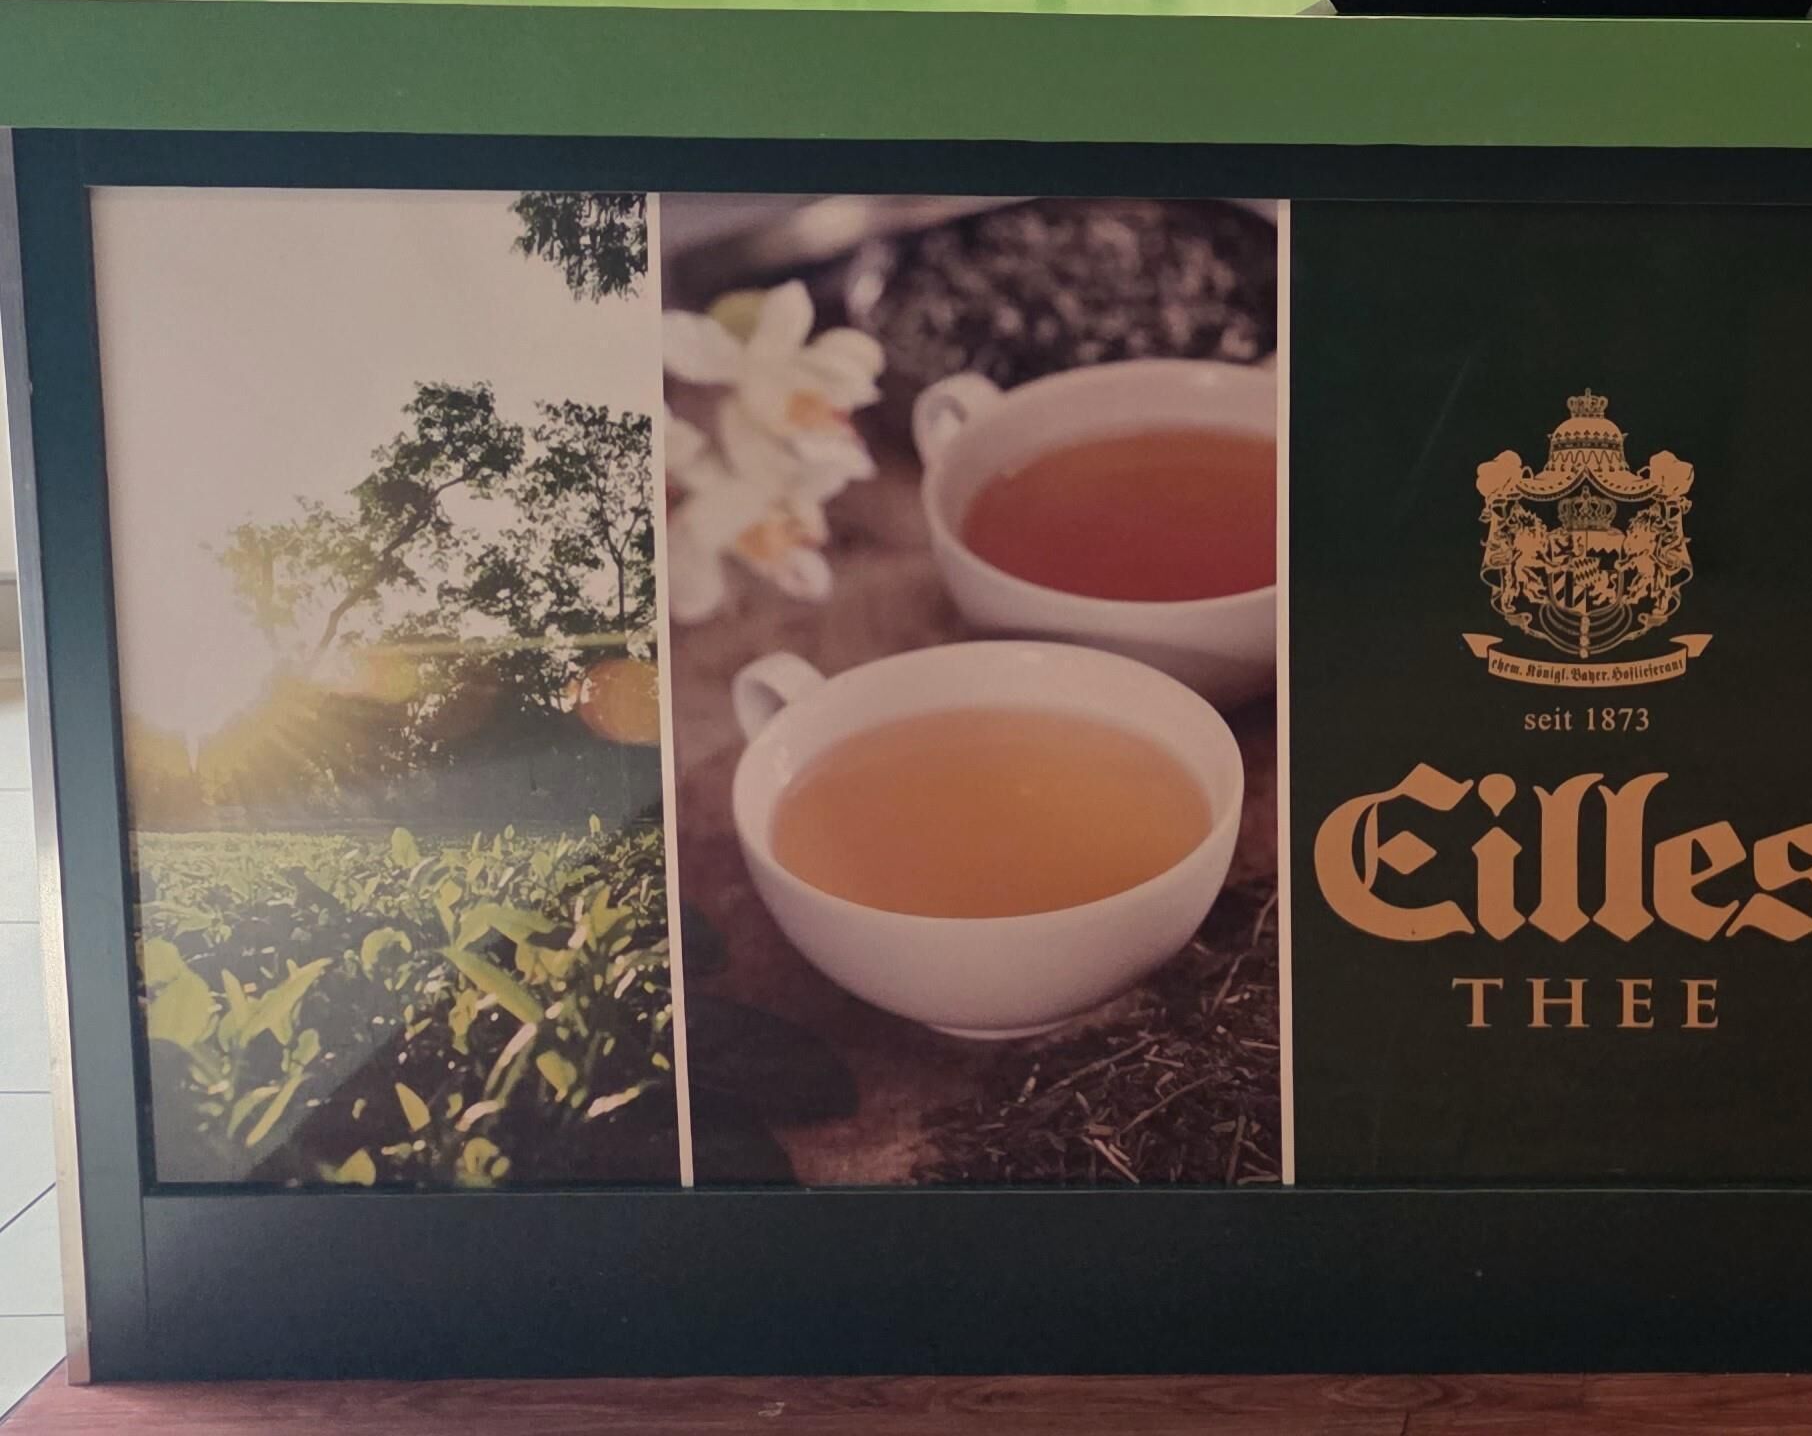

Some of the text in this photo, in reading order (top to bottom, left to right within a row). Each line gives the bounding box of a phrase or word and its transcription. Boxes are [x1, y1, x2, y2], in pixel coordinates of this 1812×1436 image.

[1491, 658, 1523, 676] ehem.
[1526, 662, 1569, 683] Königl.
[1612, 658, 1684, 682] Hoflieferant
[1523, 707, 1650, 732] seit 1873
[1451, 977, 1719, 1029] THEE
